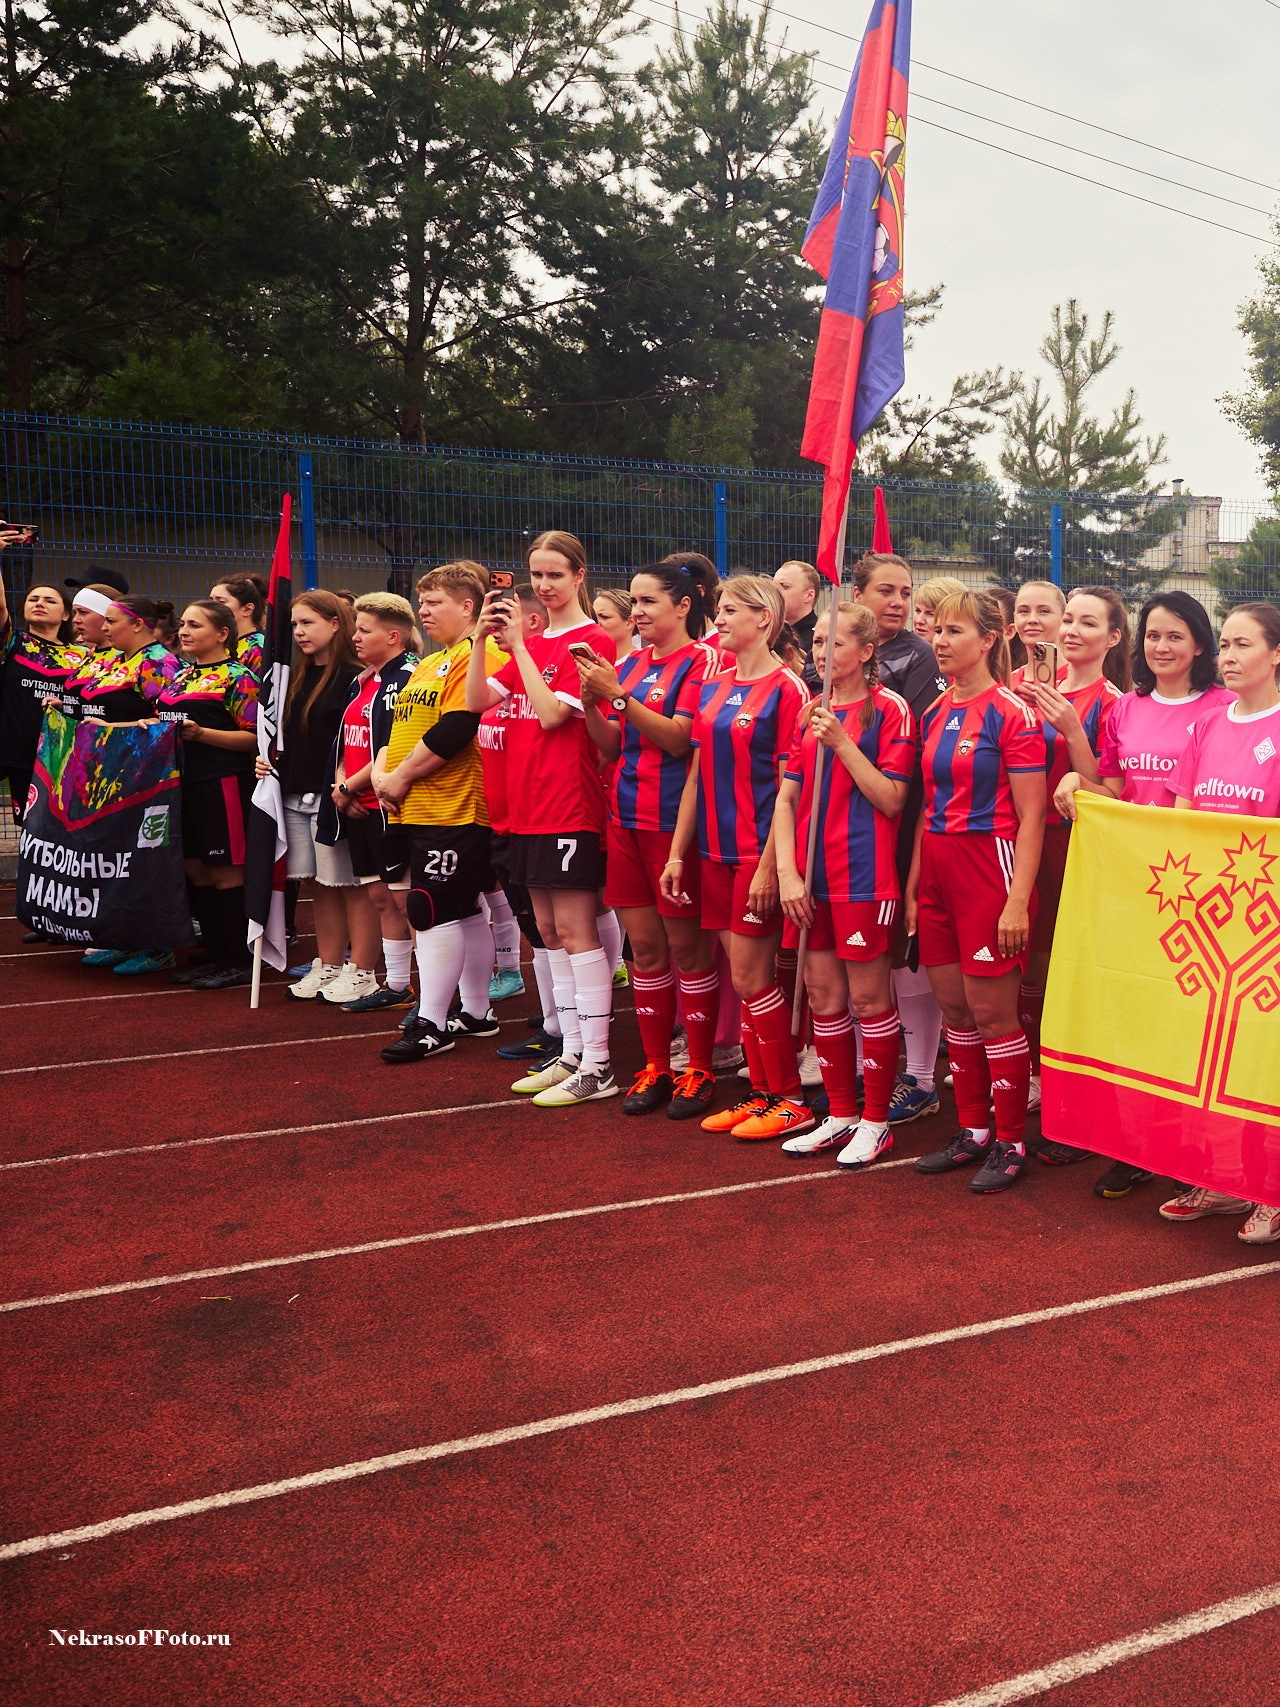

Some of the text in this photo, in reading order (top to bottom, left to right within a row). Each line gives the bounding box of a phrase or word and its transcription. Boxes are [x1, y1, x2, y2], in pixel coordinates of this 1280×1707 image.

[423, 849, 459, 876] 20
[556, 838, 578, 872] 7
[25, 873, 100, 918] МАМЫ
